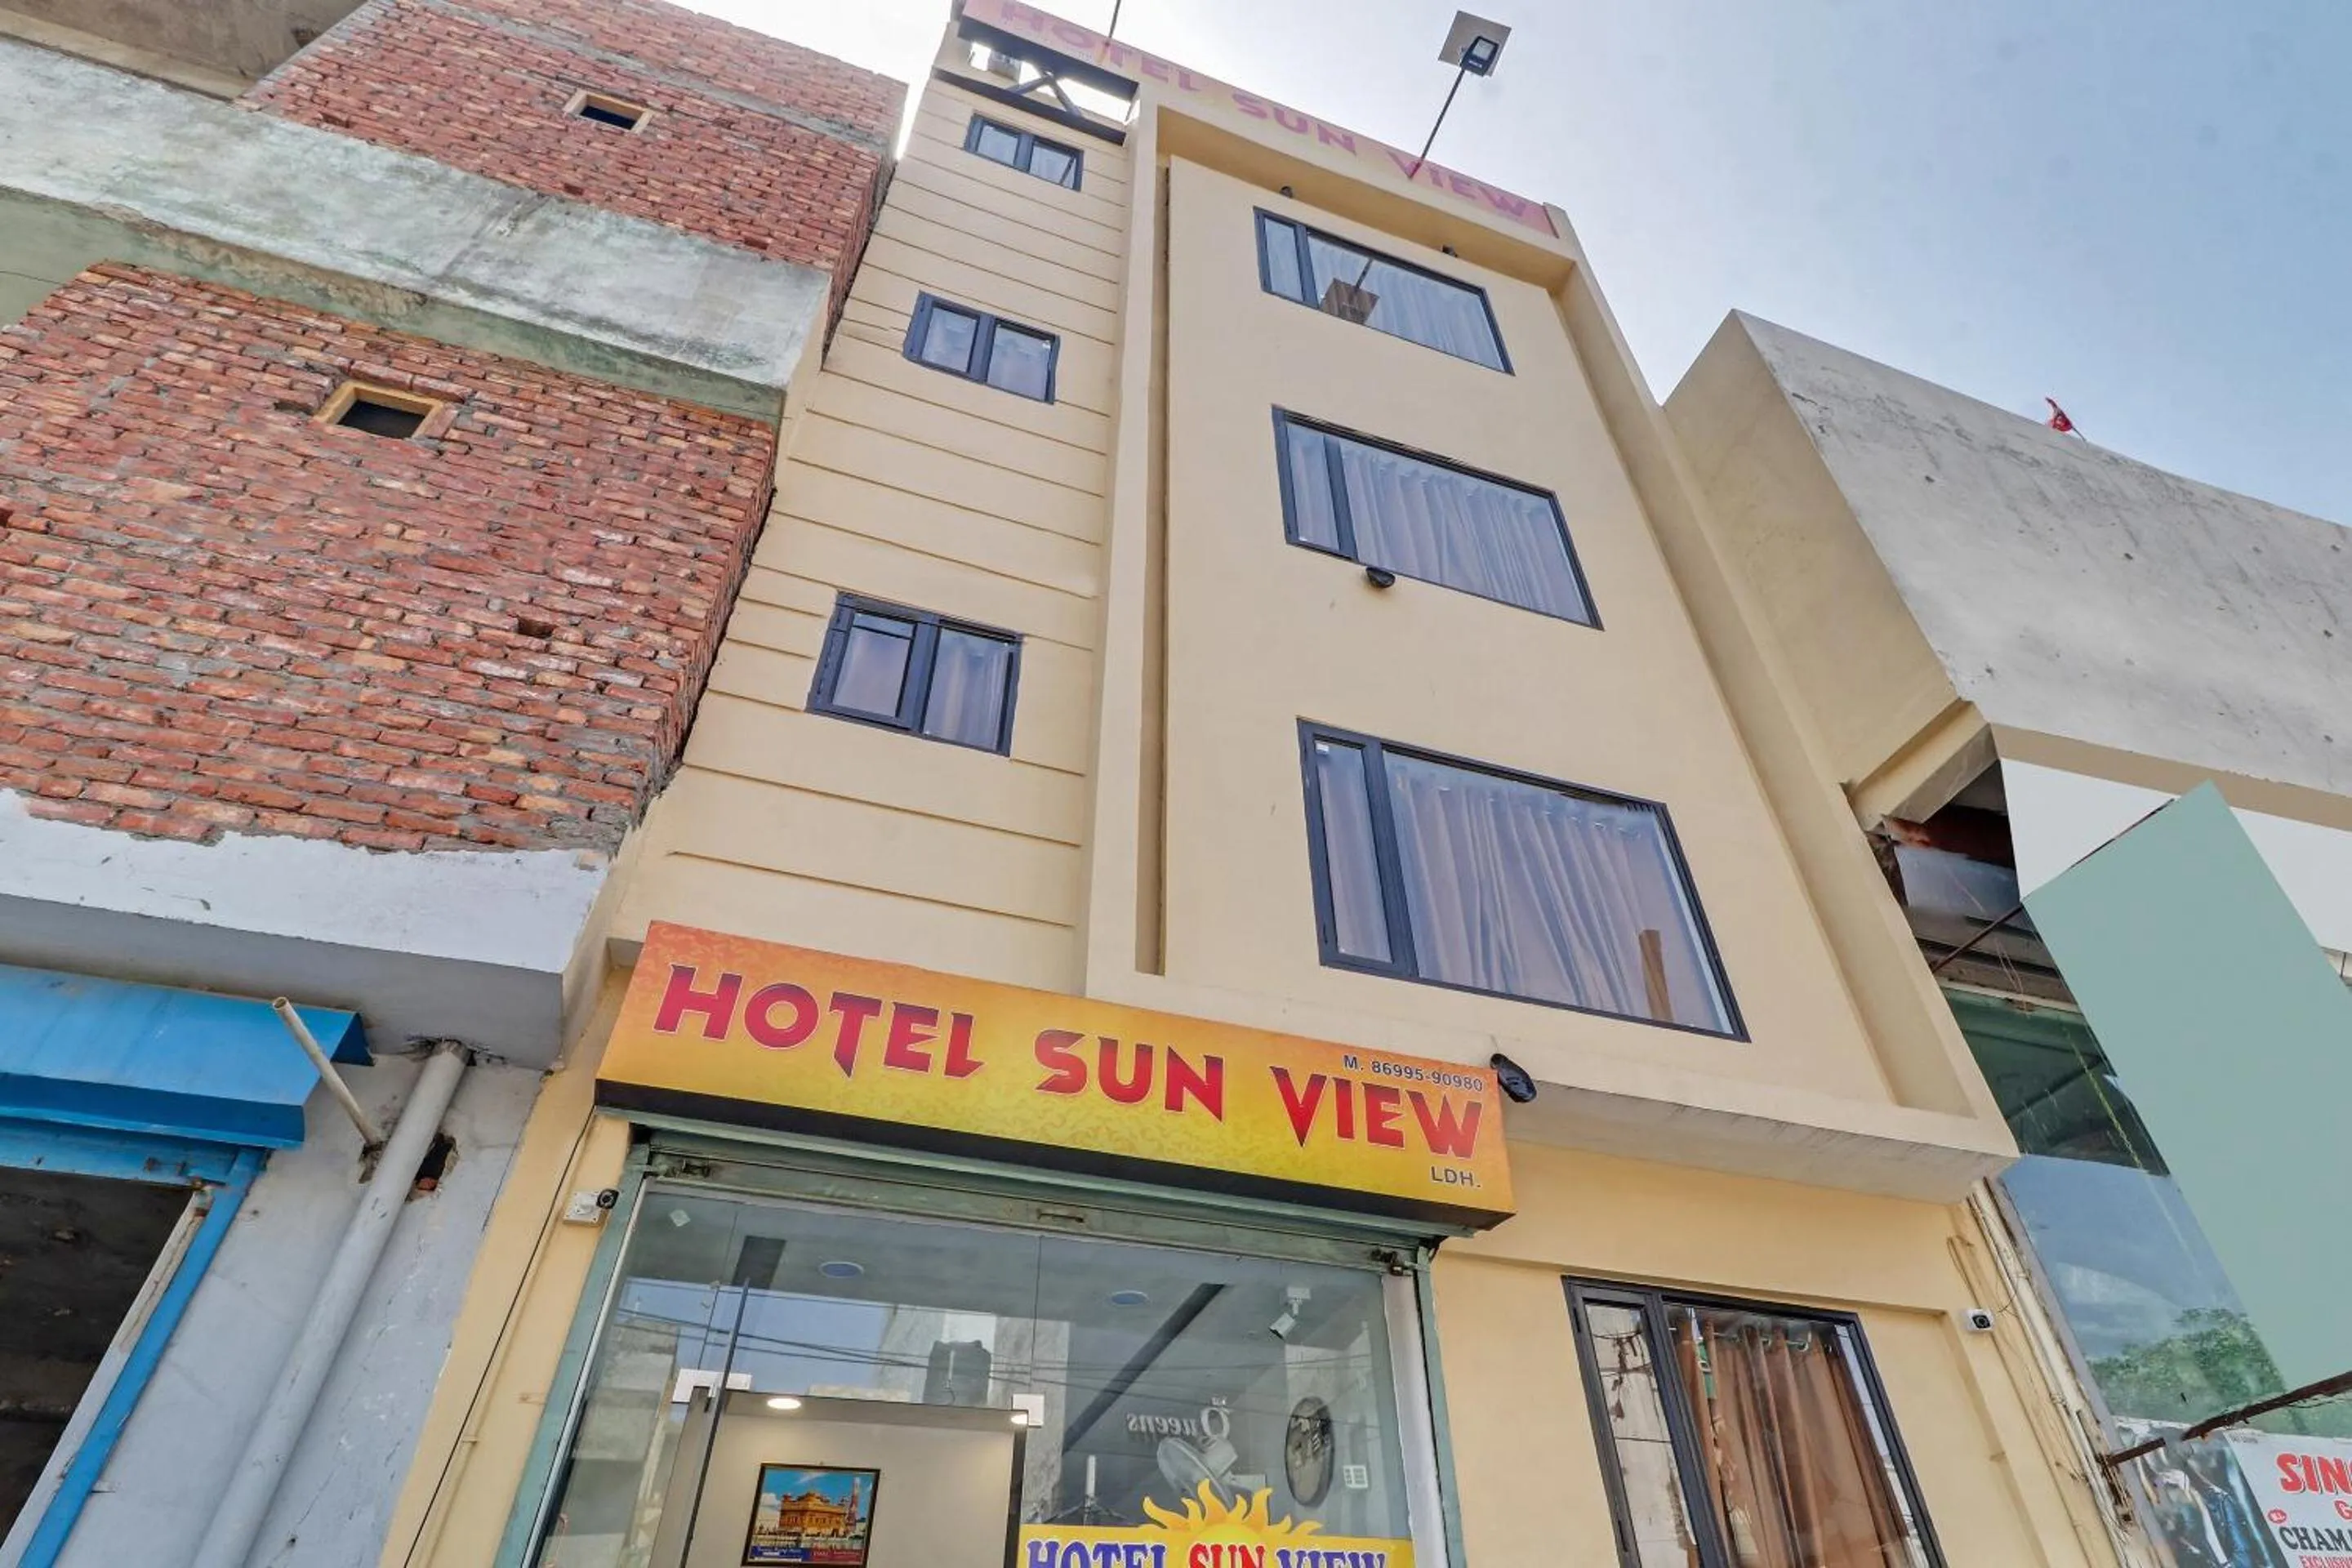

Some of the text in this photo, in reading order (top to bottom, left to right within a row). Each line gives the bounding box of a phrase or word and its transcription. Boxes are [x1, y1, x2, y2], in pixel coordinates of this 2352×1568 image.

[1000, 5, 1527, 216] HOTEL SUN VIEW
[653, 964, 1483, 1160] HOTEL SUN VIEW
[1343, 1054, 1483, 1092] M. 86995-90980
[1431, 1165, 1481, 1188] LDH.
[2276, 1453, 2352, 1494] SIN
[1188, 1543, 1266, 1568] SUN
[2279, 1526, 2352, 1552] CHAM
